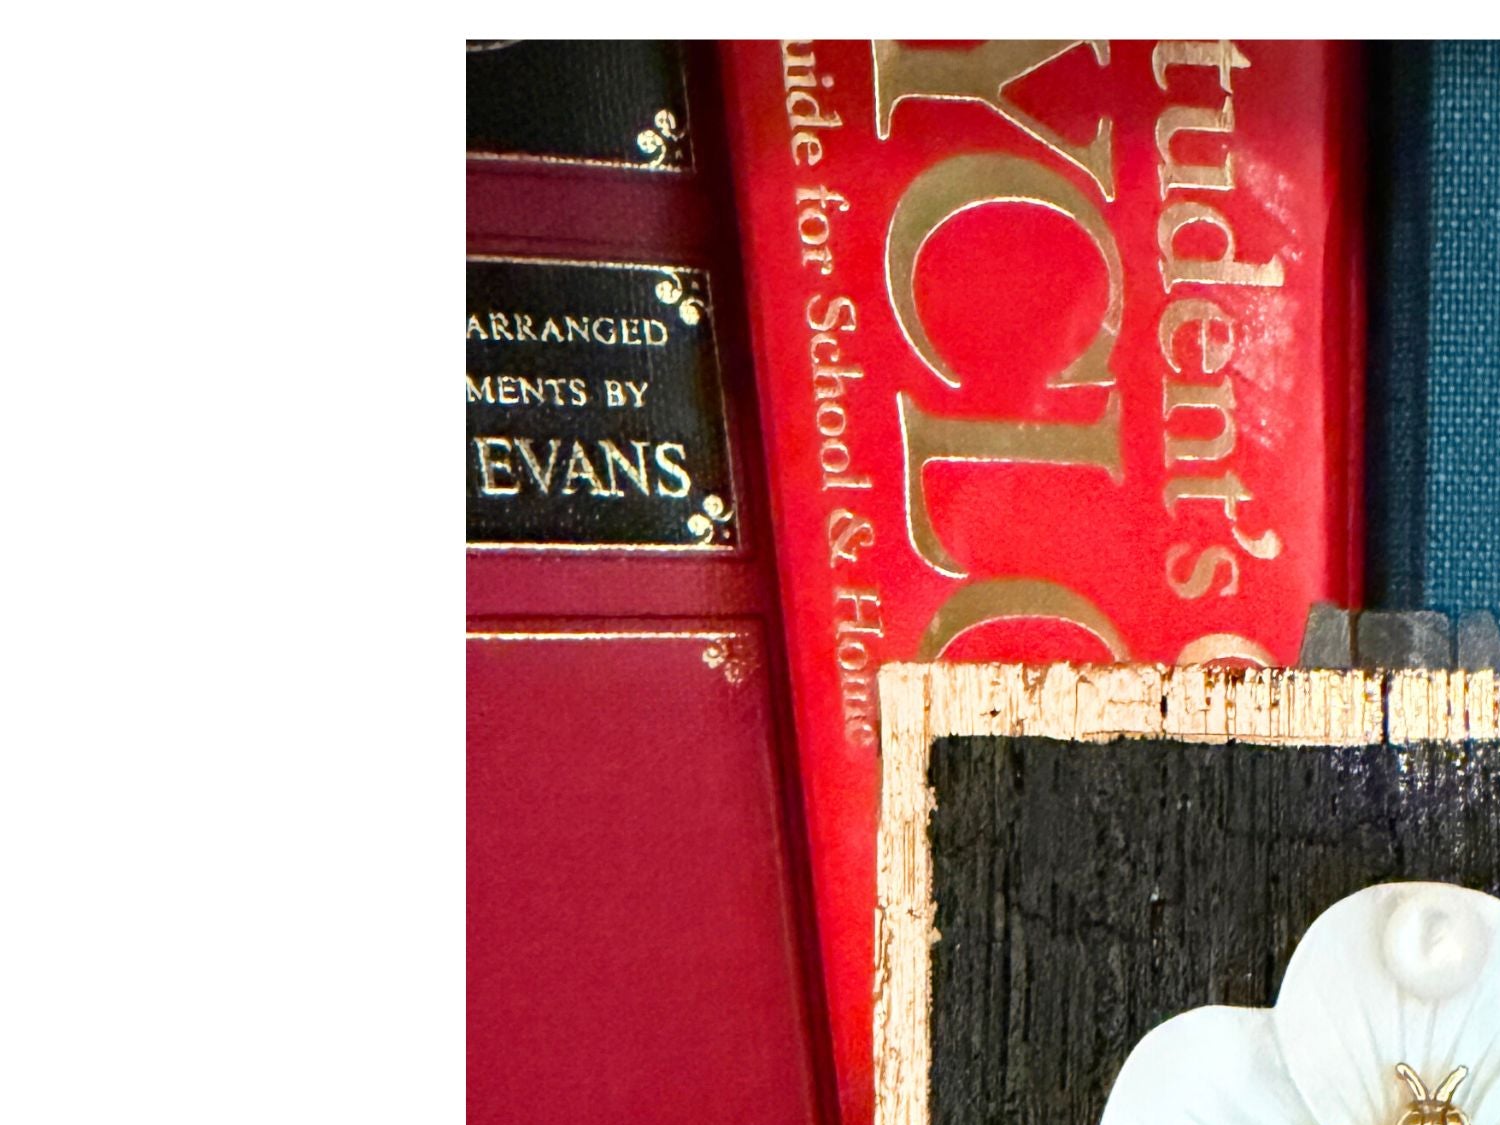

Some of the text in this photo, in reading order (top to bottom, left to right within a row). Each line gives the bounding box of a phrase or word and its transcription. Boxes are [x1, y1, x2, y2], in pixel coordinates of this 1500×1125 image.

[797, 185, 850, 276] for
[466, 311, 668, 347] ARRANGED
[872, 40, 1131, 662] YCL
[1152, 40, 1286, 599] tudent's
[466, 375, 648, 408] MENTS BY
[805, 294, 874, 492] School
[474, 435, 692, 499] EVANS
[825, 508, 875, 568] &
[833, 587, 888, 749] Home
